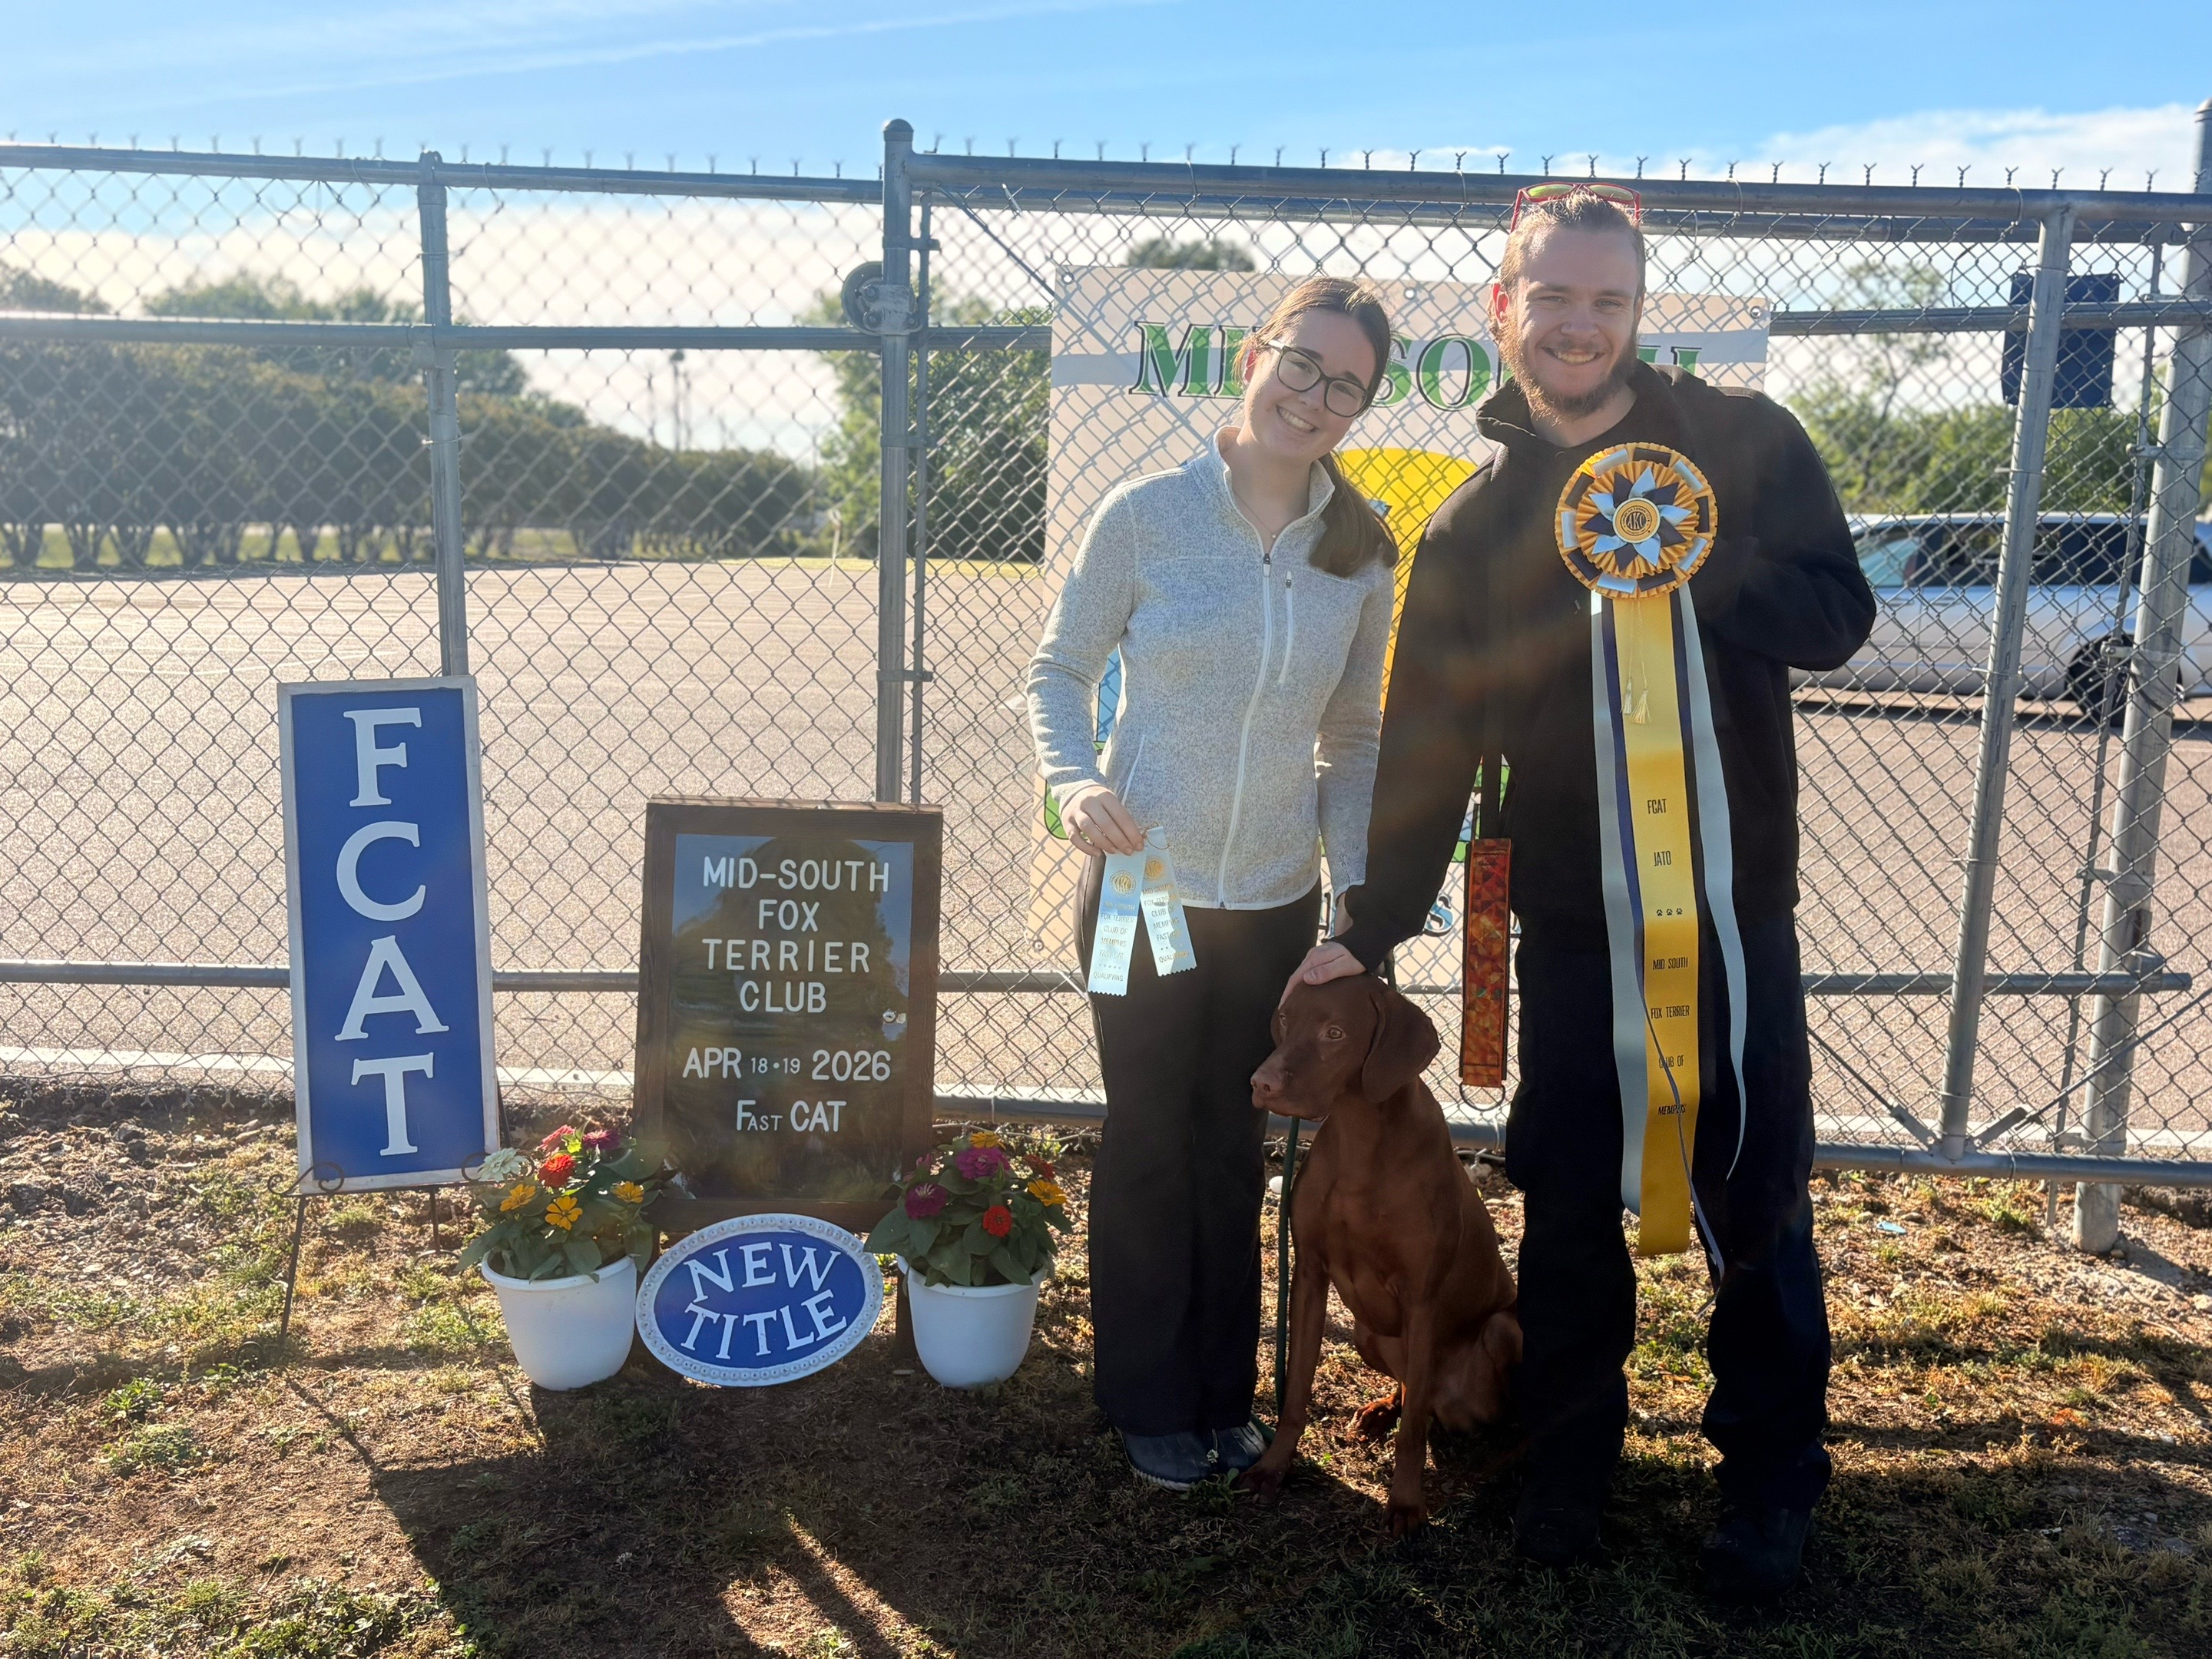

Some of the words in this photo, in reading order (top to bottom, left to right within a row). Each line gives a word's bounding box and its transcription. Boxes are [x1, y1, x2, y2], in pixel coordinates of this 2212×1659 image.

[1647, 799, 1667, 814] FCAT
[703, 856, 889, 892] MID-SOUTH
[1654, 850, 1672, 866] JATO
[758, 899, 820, 932] FOX
[1151, 909, 1166, 918] CLUB
[1168, 906, 1175, 914] OF
[335, 707, 449, 1157] FCAT
[1104, 925, 1118, 934] CLUB
[702, 939, 869, 973] TERRIER
[1653, 959, 1665, 970] MID
[1667, 957, 1688, 969] SOUTH
[740, 979, 826, 1013] CLUB
[1651, 1007, 1663, 1019] FOX
[1665, 1005, 1690, 1018] TERRIER
[682, 1047, 741, 1078] APR
[811, 1048, 891, 1081] 2026
[1677, 1055, 1684, 1067] OF
[790, 1100, 847, 1133] CAT
[683, 1242, 842, 1303] NEW
[680, 1288, 847, 1359] TITLE
